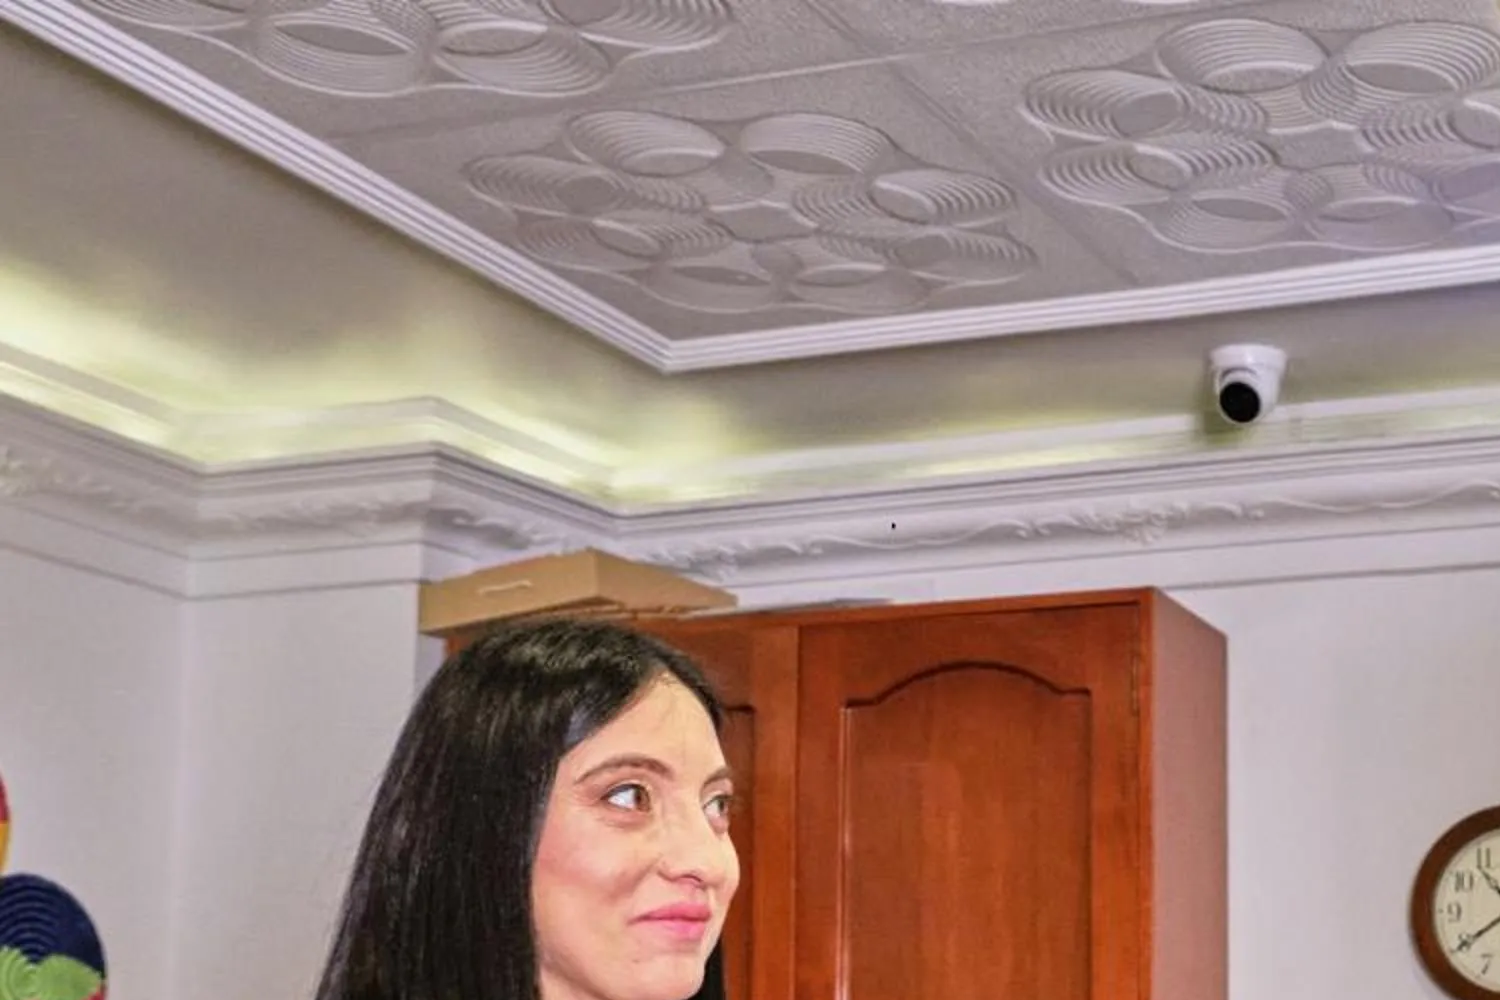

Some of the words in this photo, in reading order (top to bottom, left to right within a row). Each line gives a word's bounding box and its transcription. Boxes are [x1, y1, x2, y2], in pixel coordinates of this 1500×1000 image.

[1476, 847, 1492, 869] 11
[1454, 870, 1474, 892] 10
[1447, 902, 1462, 922] 9
[1480, 953, 1493, 975] 7
